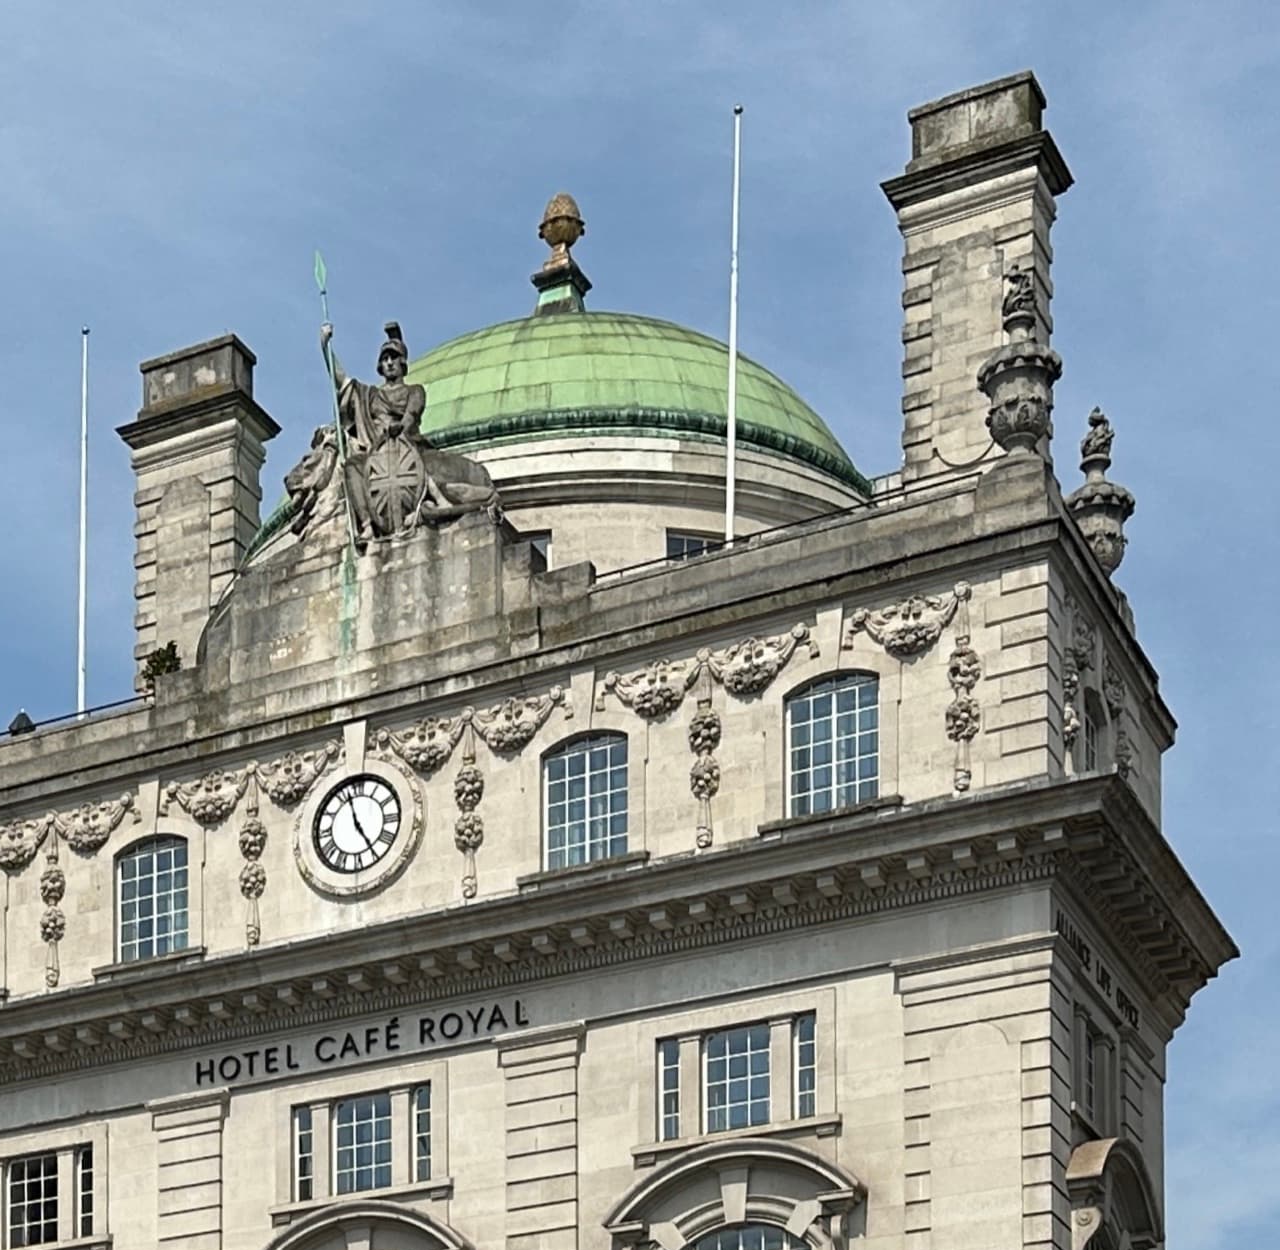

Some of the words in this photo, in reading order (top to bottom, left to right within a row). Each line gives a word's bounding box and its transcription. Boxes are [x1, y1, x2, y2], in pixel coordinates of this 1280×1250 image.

[196, 1045, 300, 1085] HOTEL
[315, 1018, 400, 1062] CAFÉ
[419, 1000, 529, 1044] ROYAL
